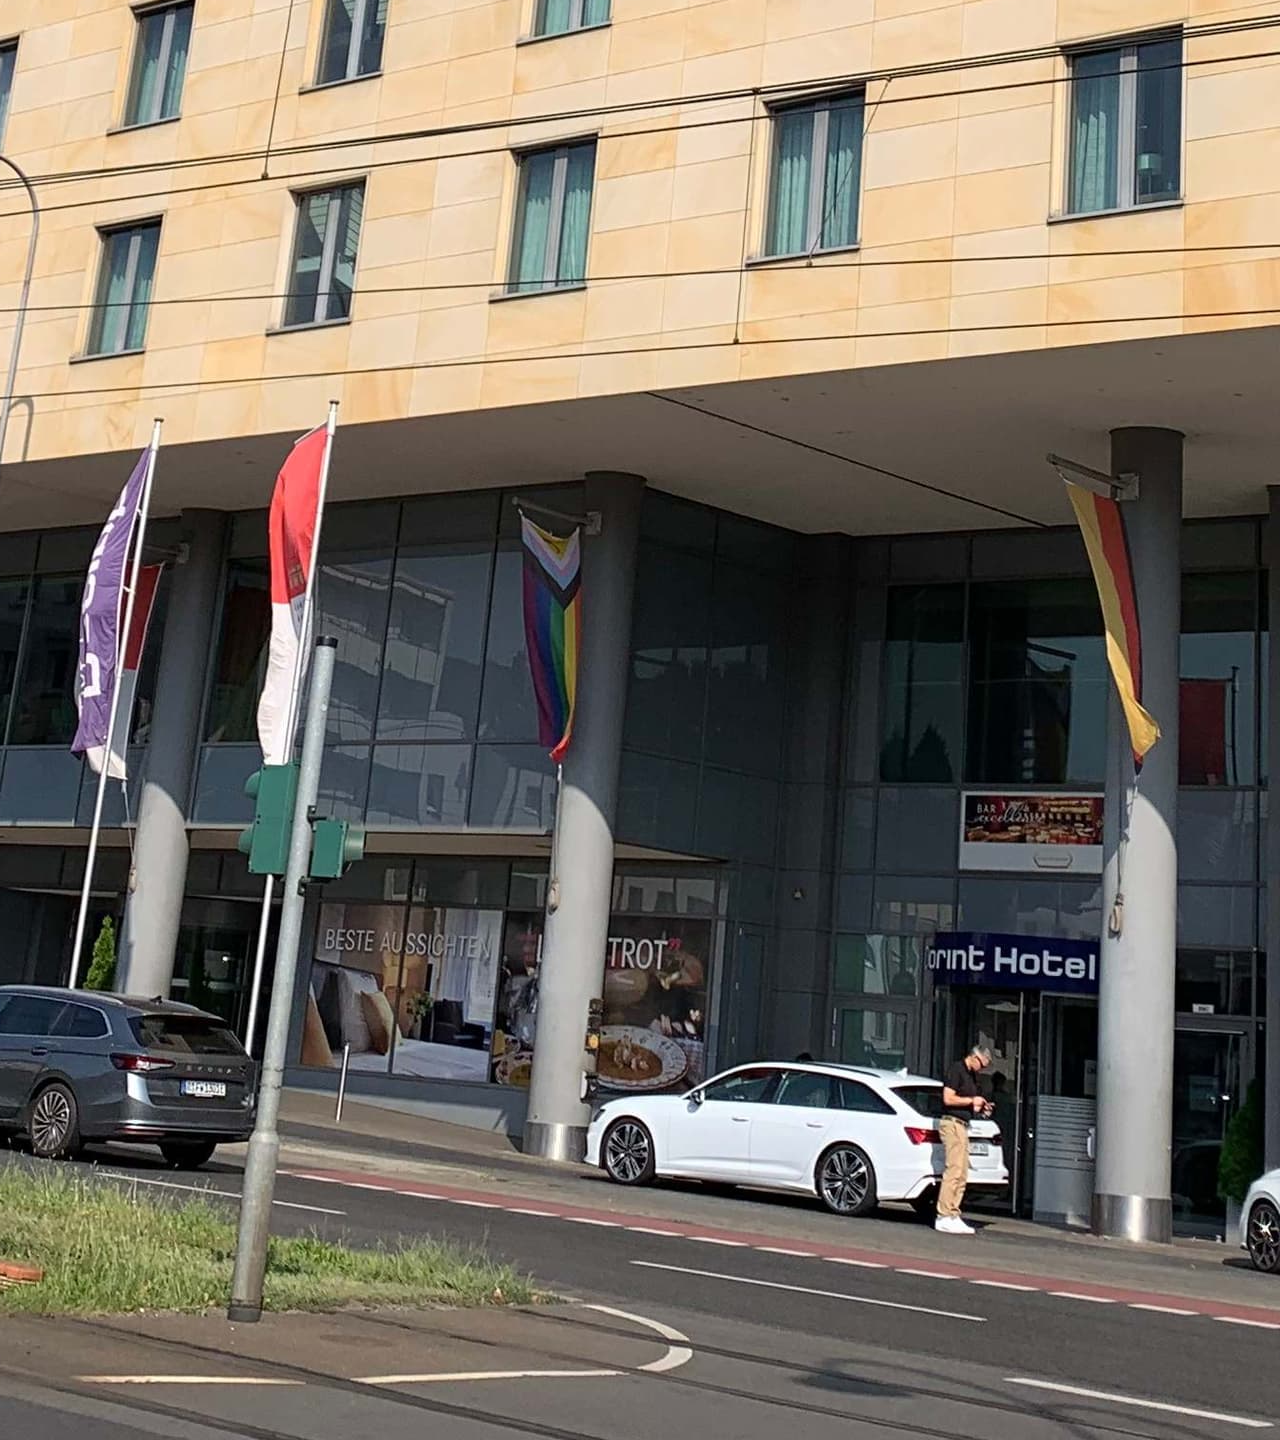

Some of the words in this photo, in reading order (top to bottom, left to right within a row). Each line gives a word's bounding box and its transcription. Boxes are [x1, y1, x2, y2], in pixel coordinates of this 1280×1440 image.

[977, 803, 997, 814] BAR
[325, 929, 374, 953] BESTE
[380, 932, 492, 960] AUSSICHTEN
[994, 946, 1096, 980] Hotel
